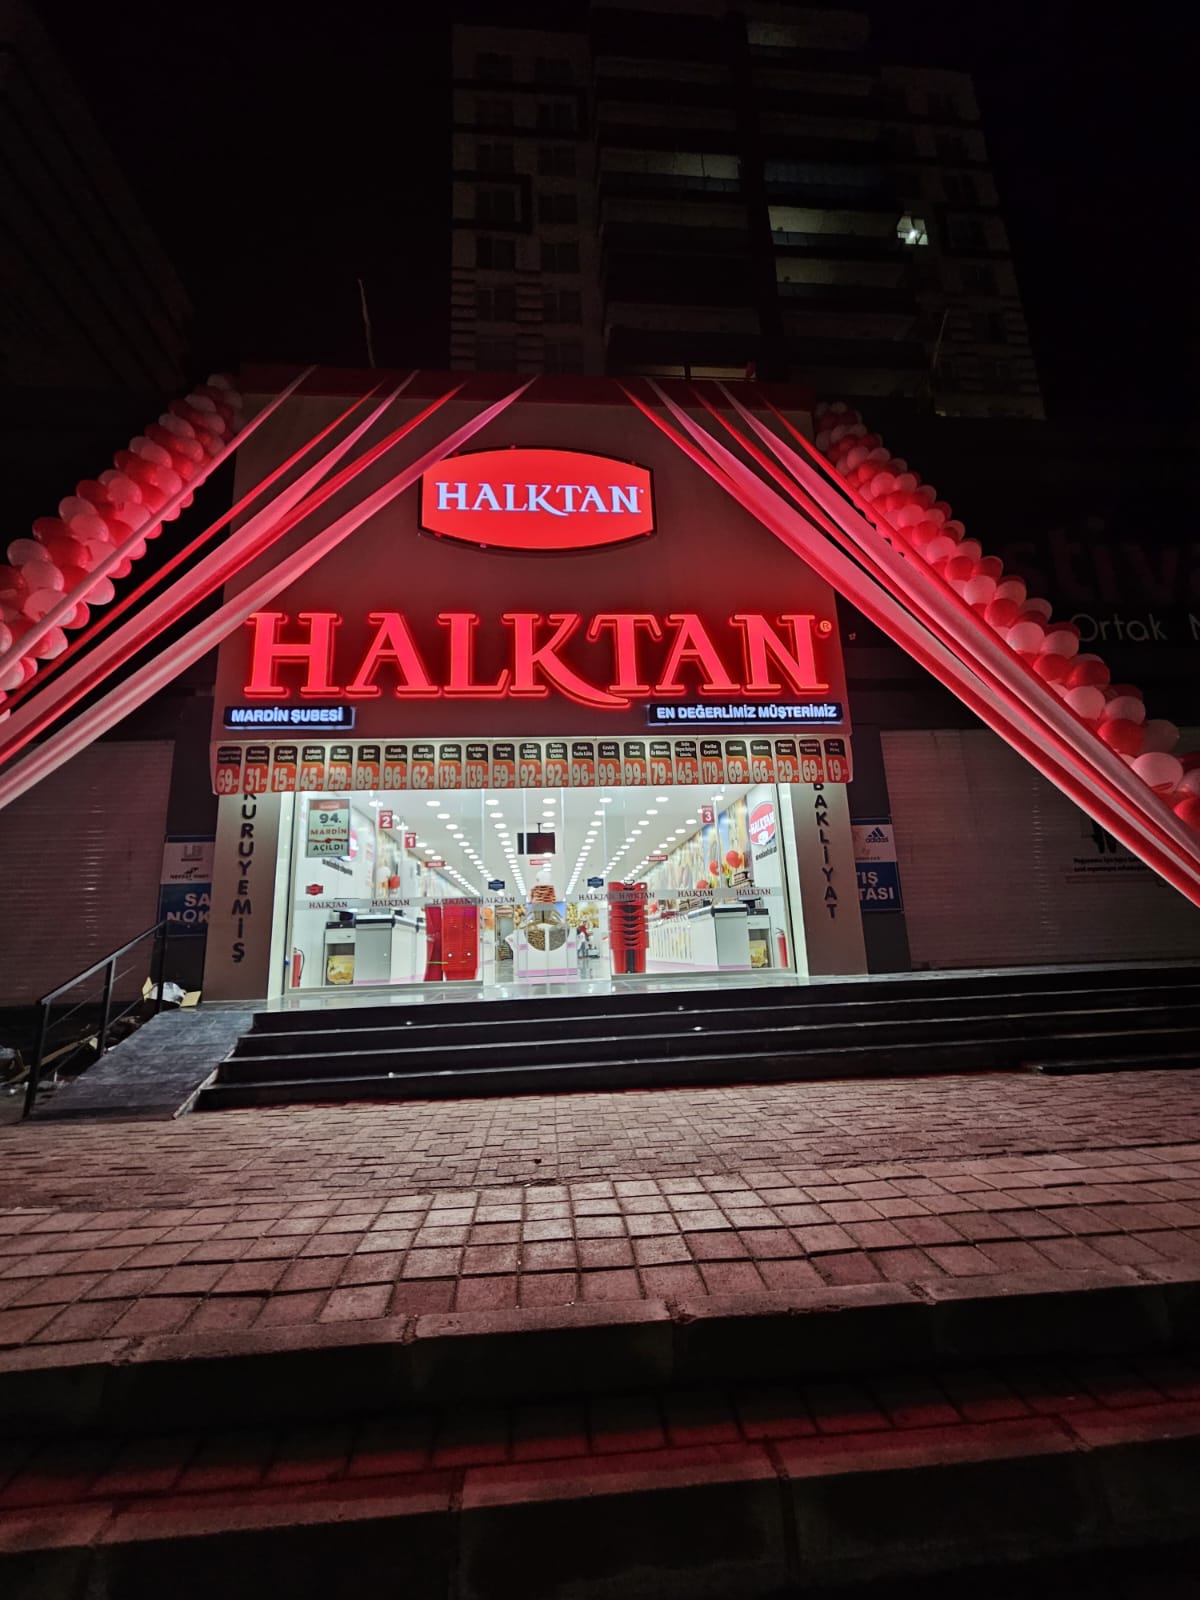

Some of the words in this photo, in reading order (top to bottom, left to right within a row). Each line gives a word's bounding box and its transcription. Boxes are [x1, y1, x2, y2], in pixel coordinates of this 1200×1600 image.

[435, 481, 642, 517] HALKTAN
[1071, 612, 1168, 642] Ortak
[243, 611, 828, 708] HALKTAN
[231, 706, 289, 722] MARDİN
[291, 706, 343, 724] ŞUBESİ
[657, 706, 675, 719] EN
[678, 703, 757, 719] DEĞERLİMİZ
[758, 703, 837, 720] MÜŞTERİMİZ
[382, 816, 391, 827] 2
[705, 811, 712, 822] 3
[310, 827, 347, 835] MARDİN
[408, 837, 414, 847] 1
[313, 844, 344, 852] AÇILDI
[857, 871, 879, 887] IŞ
[678, 890, 714, 898] HALKTAN
[736, 888, 772, 896] HALKTAN
[309, 901, 348, 909] HALKTAN
[371, 899, 410, 907] HALKTAN
